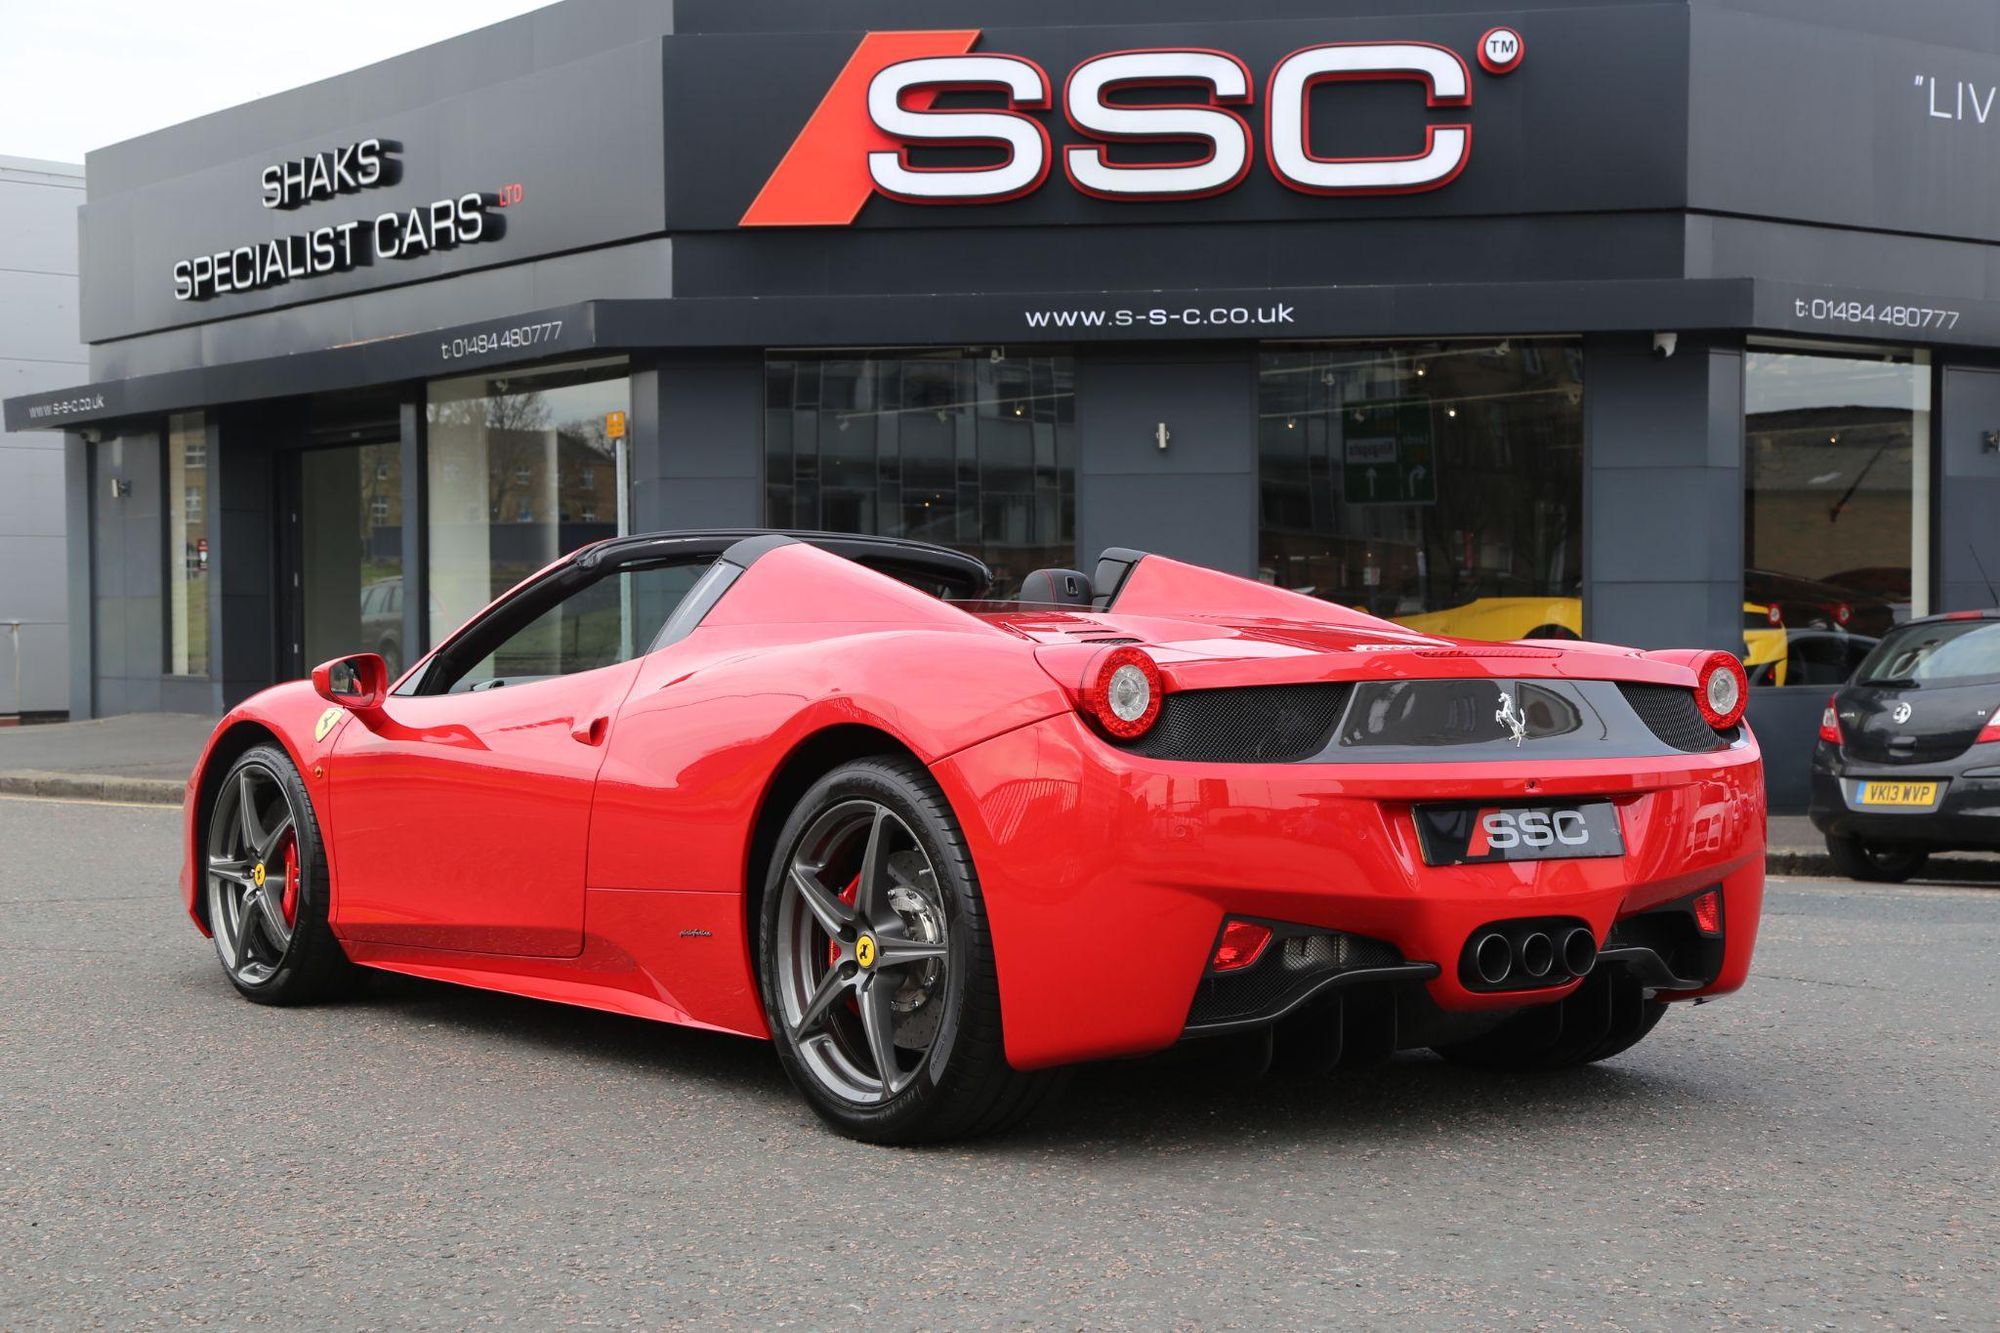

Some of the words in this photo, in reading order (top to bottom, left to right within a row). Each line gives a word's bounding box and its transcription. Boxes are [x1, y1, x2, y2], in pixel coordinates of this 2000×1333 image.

[1489, 39, 1515, 55] TM
[865, 42, 1472, 203] SSC
[262, 139, 380, 209] SHAKS
[173, 221, 358, 300] SPECIALIST
[374, 193, 483, 259] CARS
[498, 183, 523, 207] LTD
[1025, 303, 1295, 326] www.s-s-c.co.uk
[1879, 306, 1960, 329] 480777
[500, 321, 563, 348] 480777
[1870, 785, 1898, 801] VK13
[1902, 785, 1930, 801] WVP
[1482, 810, 1589, 849] SSC
